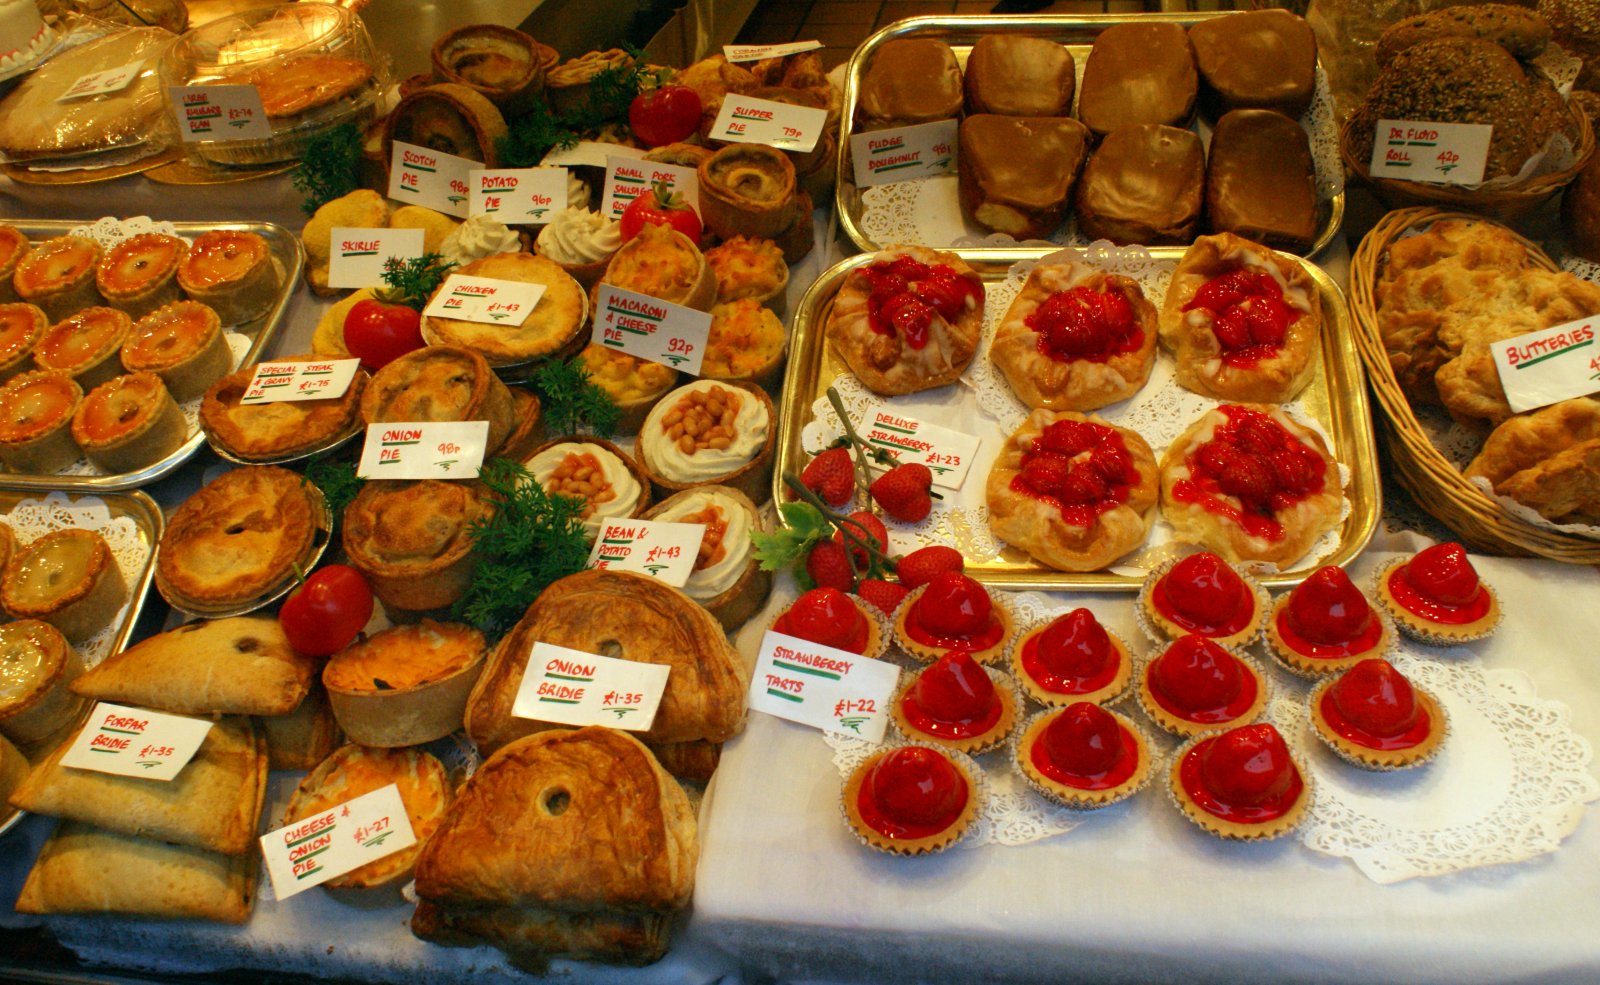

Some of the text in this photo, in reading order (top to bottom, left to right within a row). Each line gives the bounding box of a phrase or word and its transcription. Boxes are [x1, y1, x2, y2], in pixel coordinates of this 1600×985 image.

[733, 106, 773, 120] SUPPER
[728, 122, 746, 132] PIE
[1407, 128, 1438, 140] FLOYD
[868, 136, 903, 150] FUDGE
[403, 150, 436, 167] SCOTCH
[868, 151, 921, 170] DOUGHNUT
[1386, 148, 1410, 161] ROLL
[1436, 150, 1459, 164] 42p
[402, 172, 418, 186] PIE
[615, 166, 676, 182] SMALL PORK
[450, 179, 470, 195] 98p
[481, 176, 518, 188] POTATO
[613, 184, 653, 196] SAUSAG
[485, 196, 501, 208] PIE
[531, 194, 552, 206] 96p
[341, 240, 381, 251] SKIRLIE
[454, 284, 497, 296] CHICKEN
[445, 298, 463, 307] PIE
[608, 295, 667, 319] MACARONI
[617, 316, 658, 333] CHEESE
[604, 328, 623, 341] PIE
[1506, 324, 1594, 365] BUTTERIES
[260, 364, 335, 375] SPECIAL STEAK
[264, 376, 294, 386] GRAVY
[249, 389, 265, 397] PIE
[876, 412, 919, 430] DELUXE
[382, 429, 422, 442] ONION
[867, 430, 934, 452] STRAWBERRY
[380, 448, 400, 460] PIE
[437, 443, 461, 456] 98p
[604, 525, 649, 540] BEAN &
[597, 544, 632, 557] POTATO
[773, 646, 854, 675] STRAWBERRY
[545, 659, 596, 677] ONION
[766, 674, 804, 693] TARTS
[536, 682, 586, 700] BRIDIE
[103, 714, 149, 732] FORFAR
[90, 734, 132, 750] BRIDIE
[284, 813, 337, 844] CHEESE
[288, 833, 332, 862] ONION
[292, 858, 317, 877] PIE
